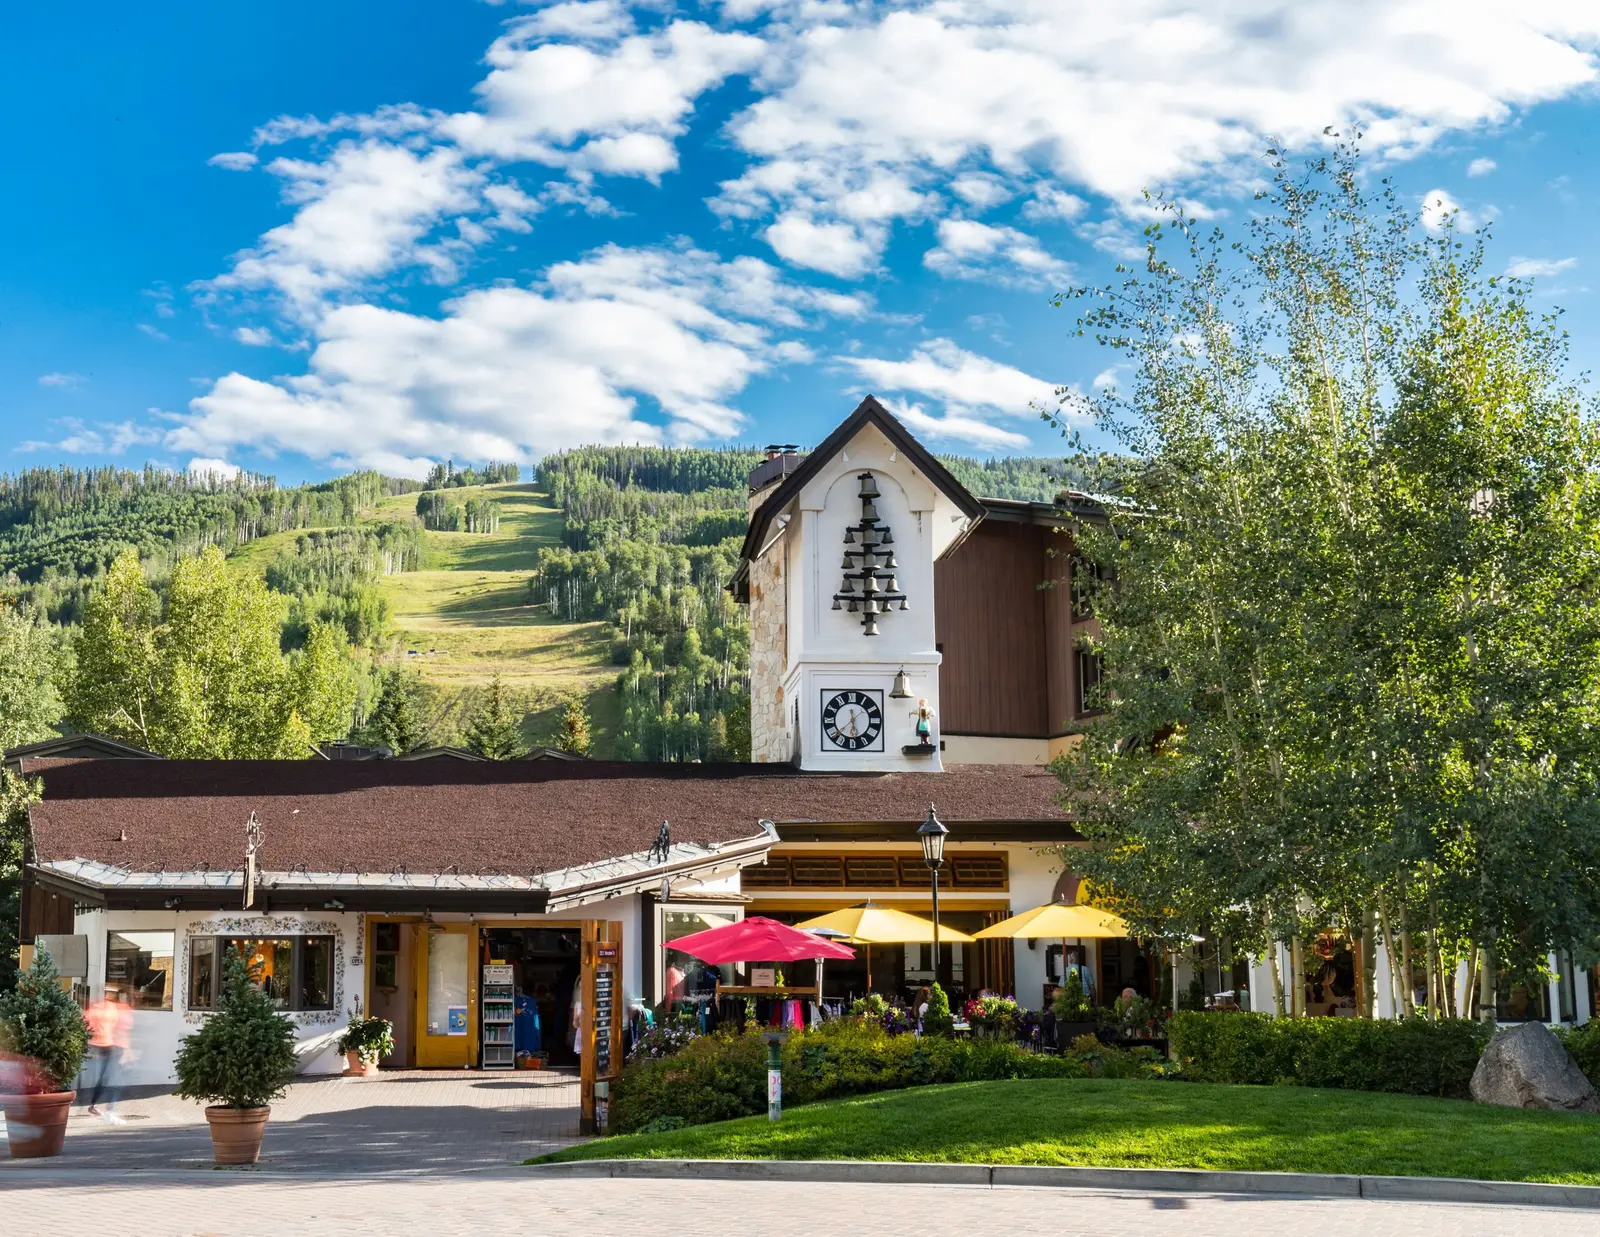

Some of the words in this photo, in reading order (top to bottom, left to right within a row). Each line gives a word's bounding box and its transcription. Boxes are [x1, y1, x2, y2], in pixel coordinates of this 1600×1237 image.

[835, 696, 845, 706] XI
[848, 693, 857, 702] XII
[860, 696, 867, 705] I
[827, 704, 837, 713] X
[849, 739, 856, 748] VI
[861, 737, 868, 745] V
